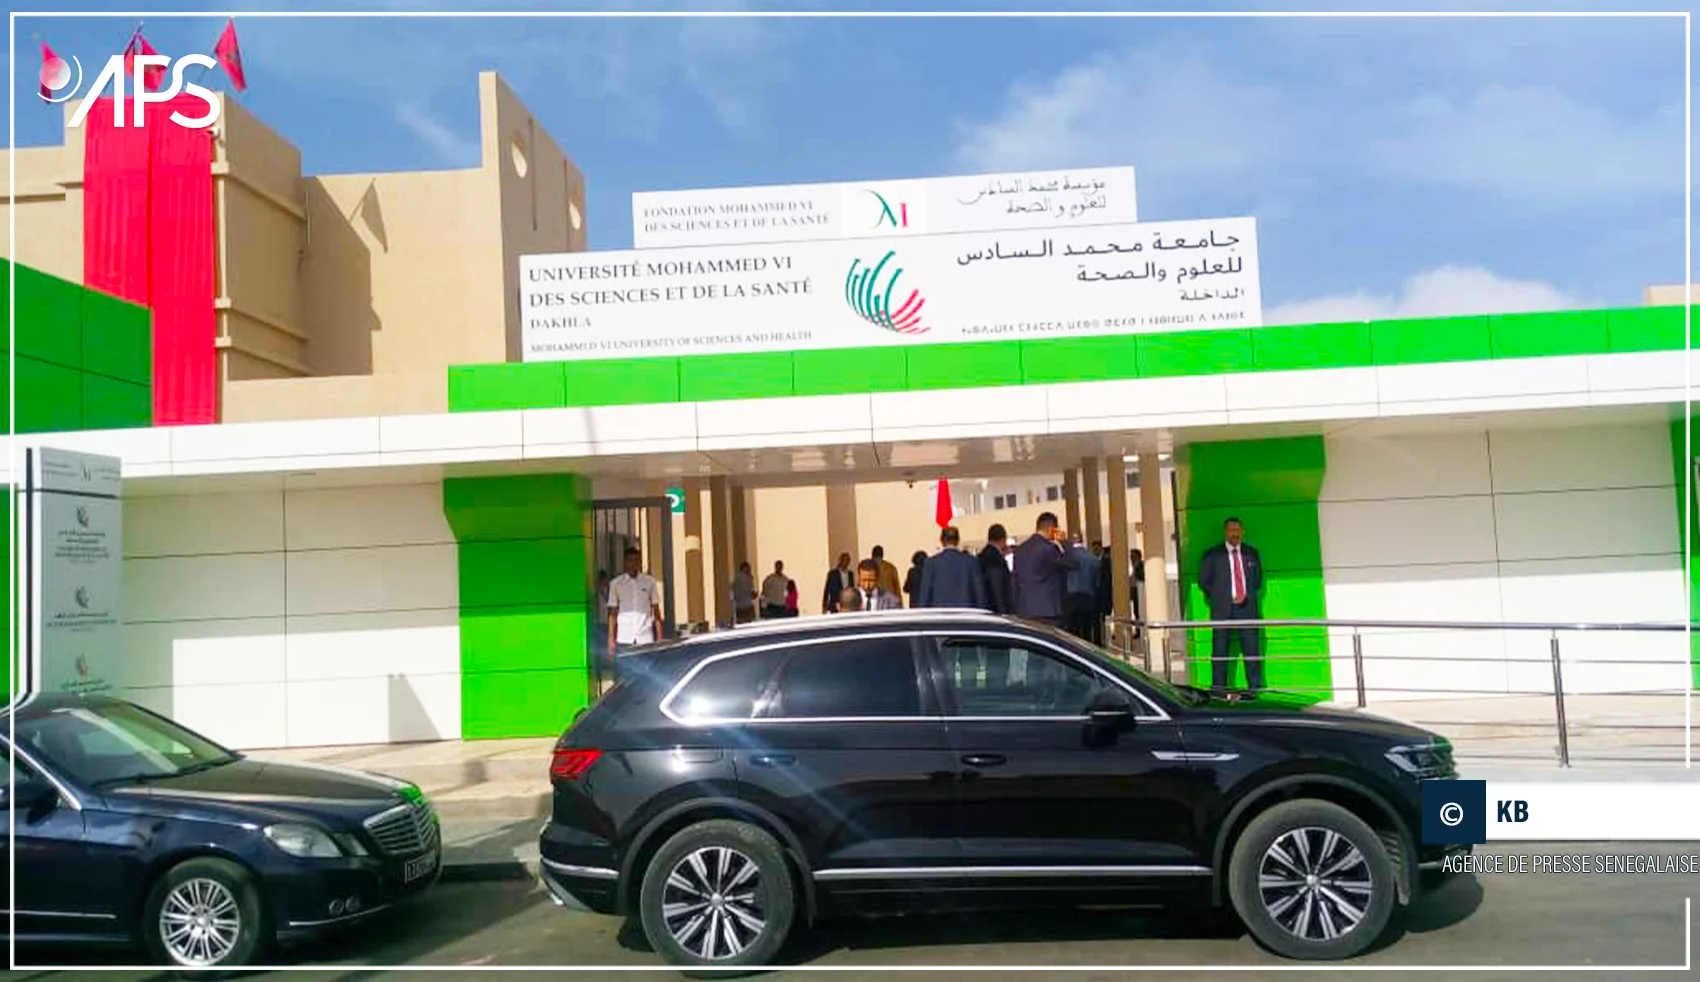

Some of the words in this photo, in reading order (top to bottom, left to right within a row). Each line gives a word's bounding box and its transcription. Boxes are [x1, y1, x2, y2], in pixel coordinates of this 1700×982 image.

[644, 204, 715, 218] FONDATION
[720, 201, 798, 215] MOHAMMED
[799, 200, 813, 211] VI
[644, 221, 668, 233] DES
[669, 218, 731, 232] SCIENCES
[733, 217, 748, 228] ET
[752, 216, 766, 228] DE
[772, 215, 786, 226] LA
[786, 212, 830, 226] SANTÉ
[1063, 240, 1143, 256] محمد
[1152, 230, 1240, 252] جامعة
[956, 239, 1053, 266] السادس
[529, 260, 642, 283] UNIVERSITÉ
[647, 257, 767, 277] MOHAMMED
[773, 256, 792, 270] VI
[1176, 257, 1243, 283] للعلوم
[529, 292, 565, 307] DES
[570, 286, 660, 306] SCIENCES
[666, 286, 688, 301] ET
[692, 284, 718, 299] DE
[723, 283, 746, 298] LA
[751, 277, 813, 296] SANTÉ
[530, 316, 592, 330] DAKHLA
[530, 341, 597, 353] MOHAMMED
[600, 340, 612, 350] VI
[613, 337, 676, 350] UNIVERSITY
[677, 336, 690, 346] OF
[693, 334, 742, 346] SCIENCES
[745, 332, 768, 343] AND
[771, 330, 812, 342] HEALTH
